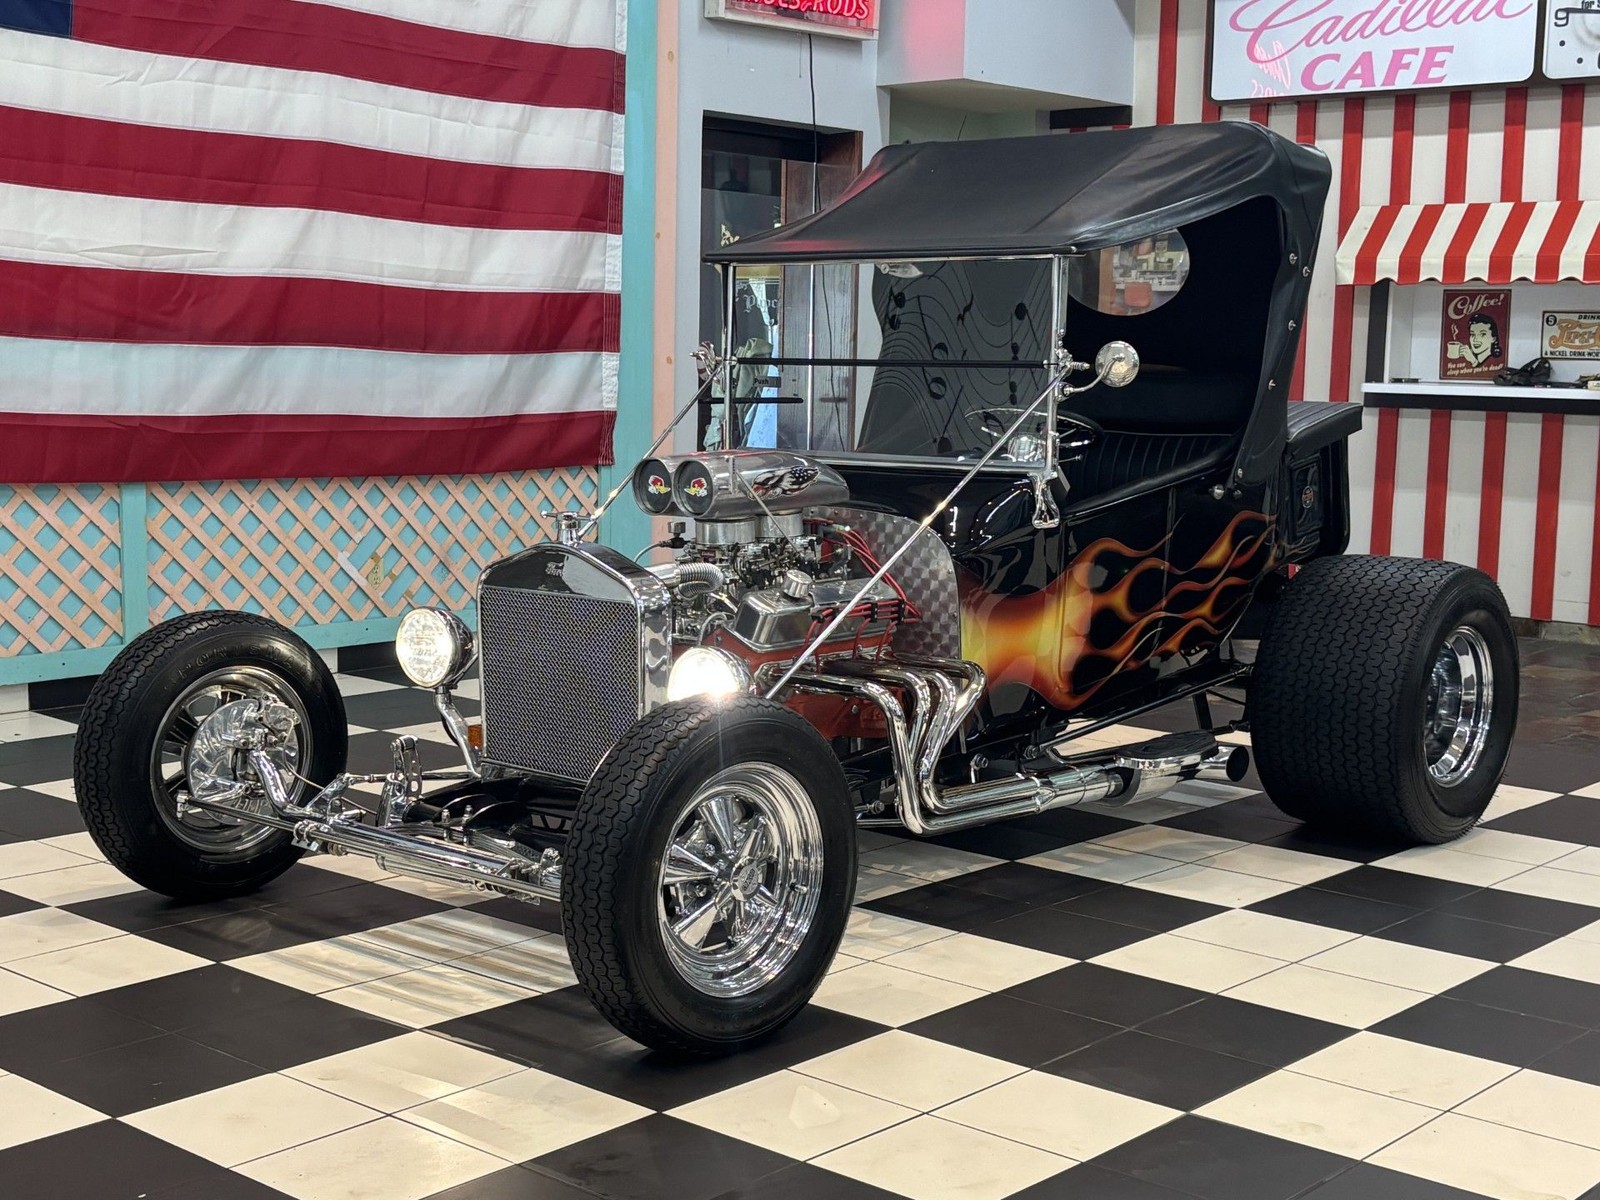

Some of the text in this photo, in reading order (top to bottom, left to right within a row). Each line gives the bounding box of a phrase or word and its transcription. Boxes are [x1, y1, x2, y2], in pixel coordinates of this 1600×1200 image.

[812, 0, 869, 19] RODS
[1301, 45, 1454, 91] CAFE
[1448, 293, 1505, 320] Coffee!
